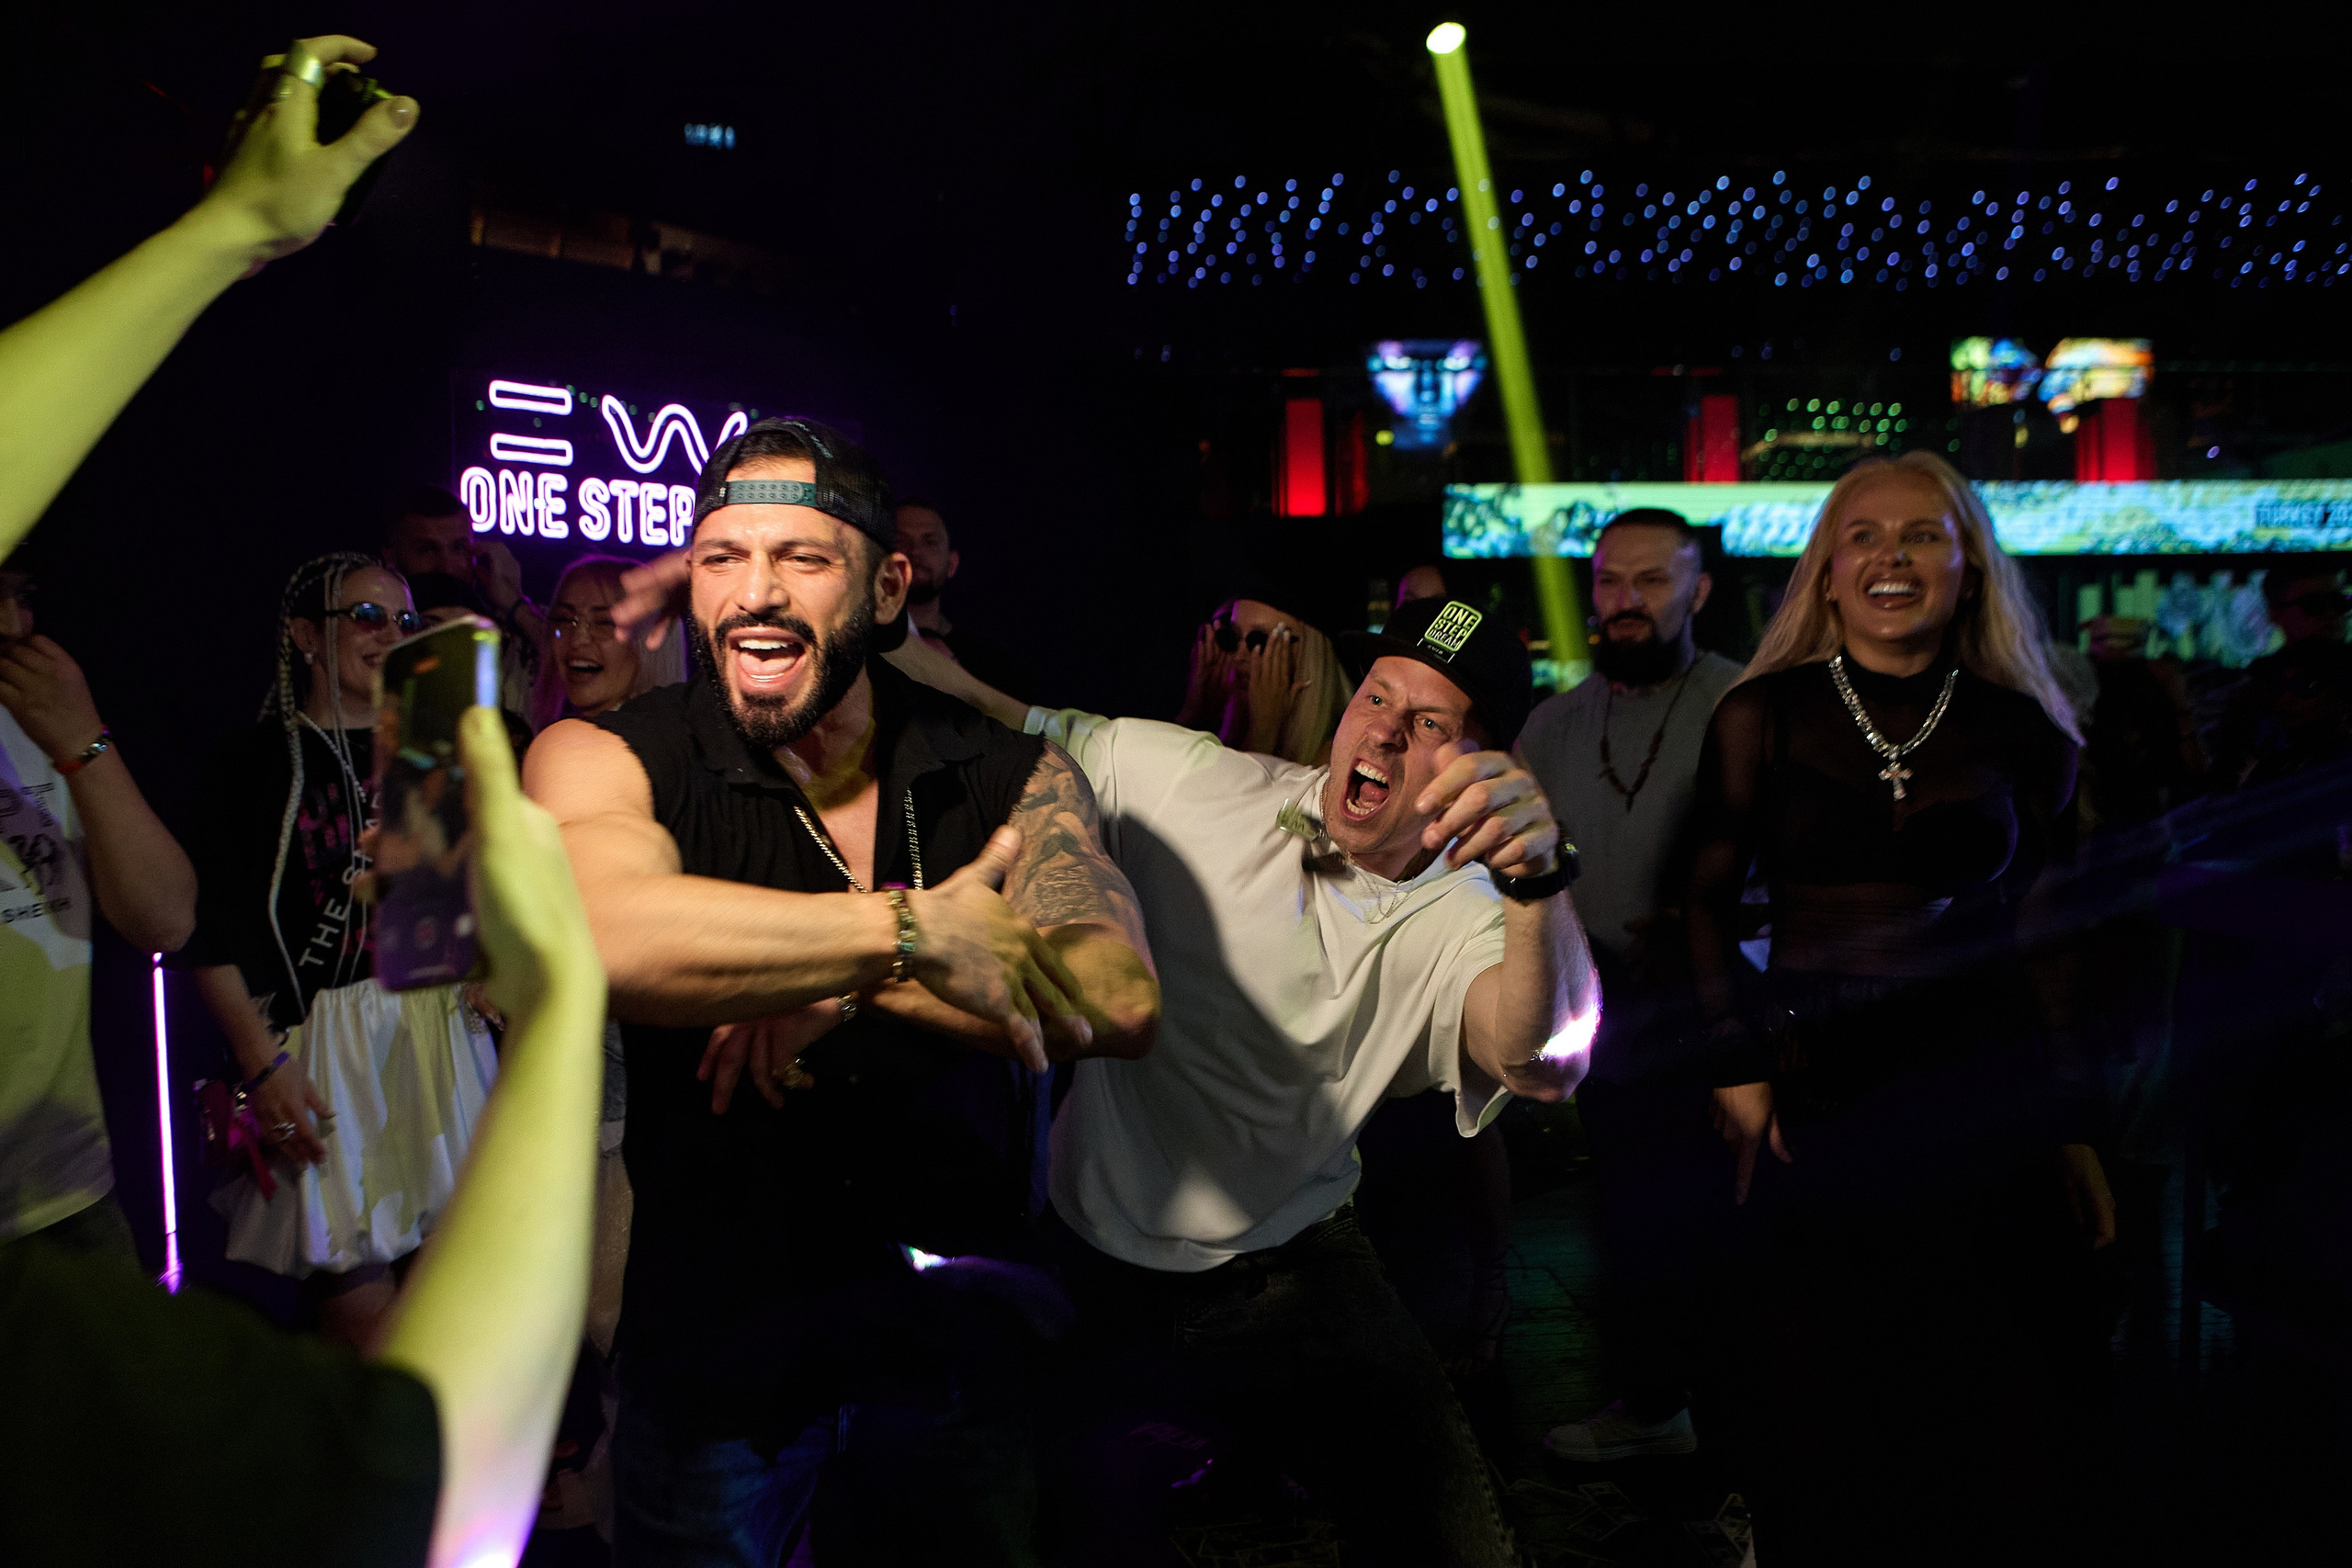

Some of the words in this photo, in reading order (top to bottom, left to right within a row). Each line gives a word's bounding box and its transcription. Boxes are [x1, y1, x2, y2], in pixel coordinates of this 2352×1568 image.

[460, 467, 569, 539] ONE
[578, 477, 696, 547] STEP
[1434, 618, 1468, 638] STEP
[1443, 606, 1477, 629] ONE
[1428, 629, 1462, 649] DREAM
[298, 897, 347, 967] THE
